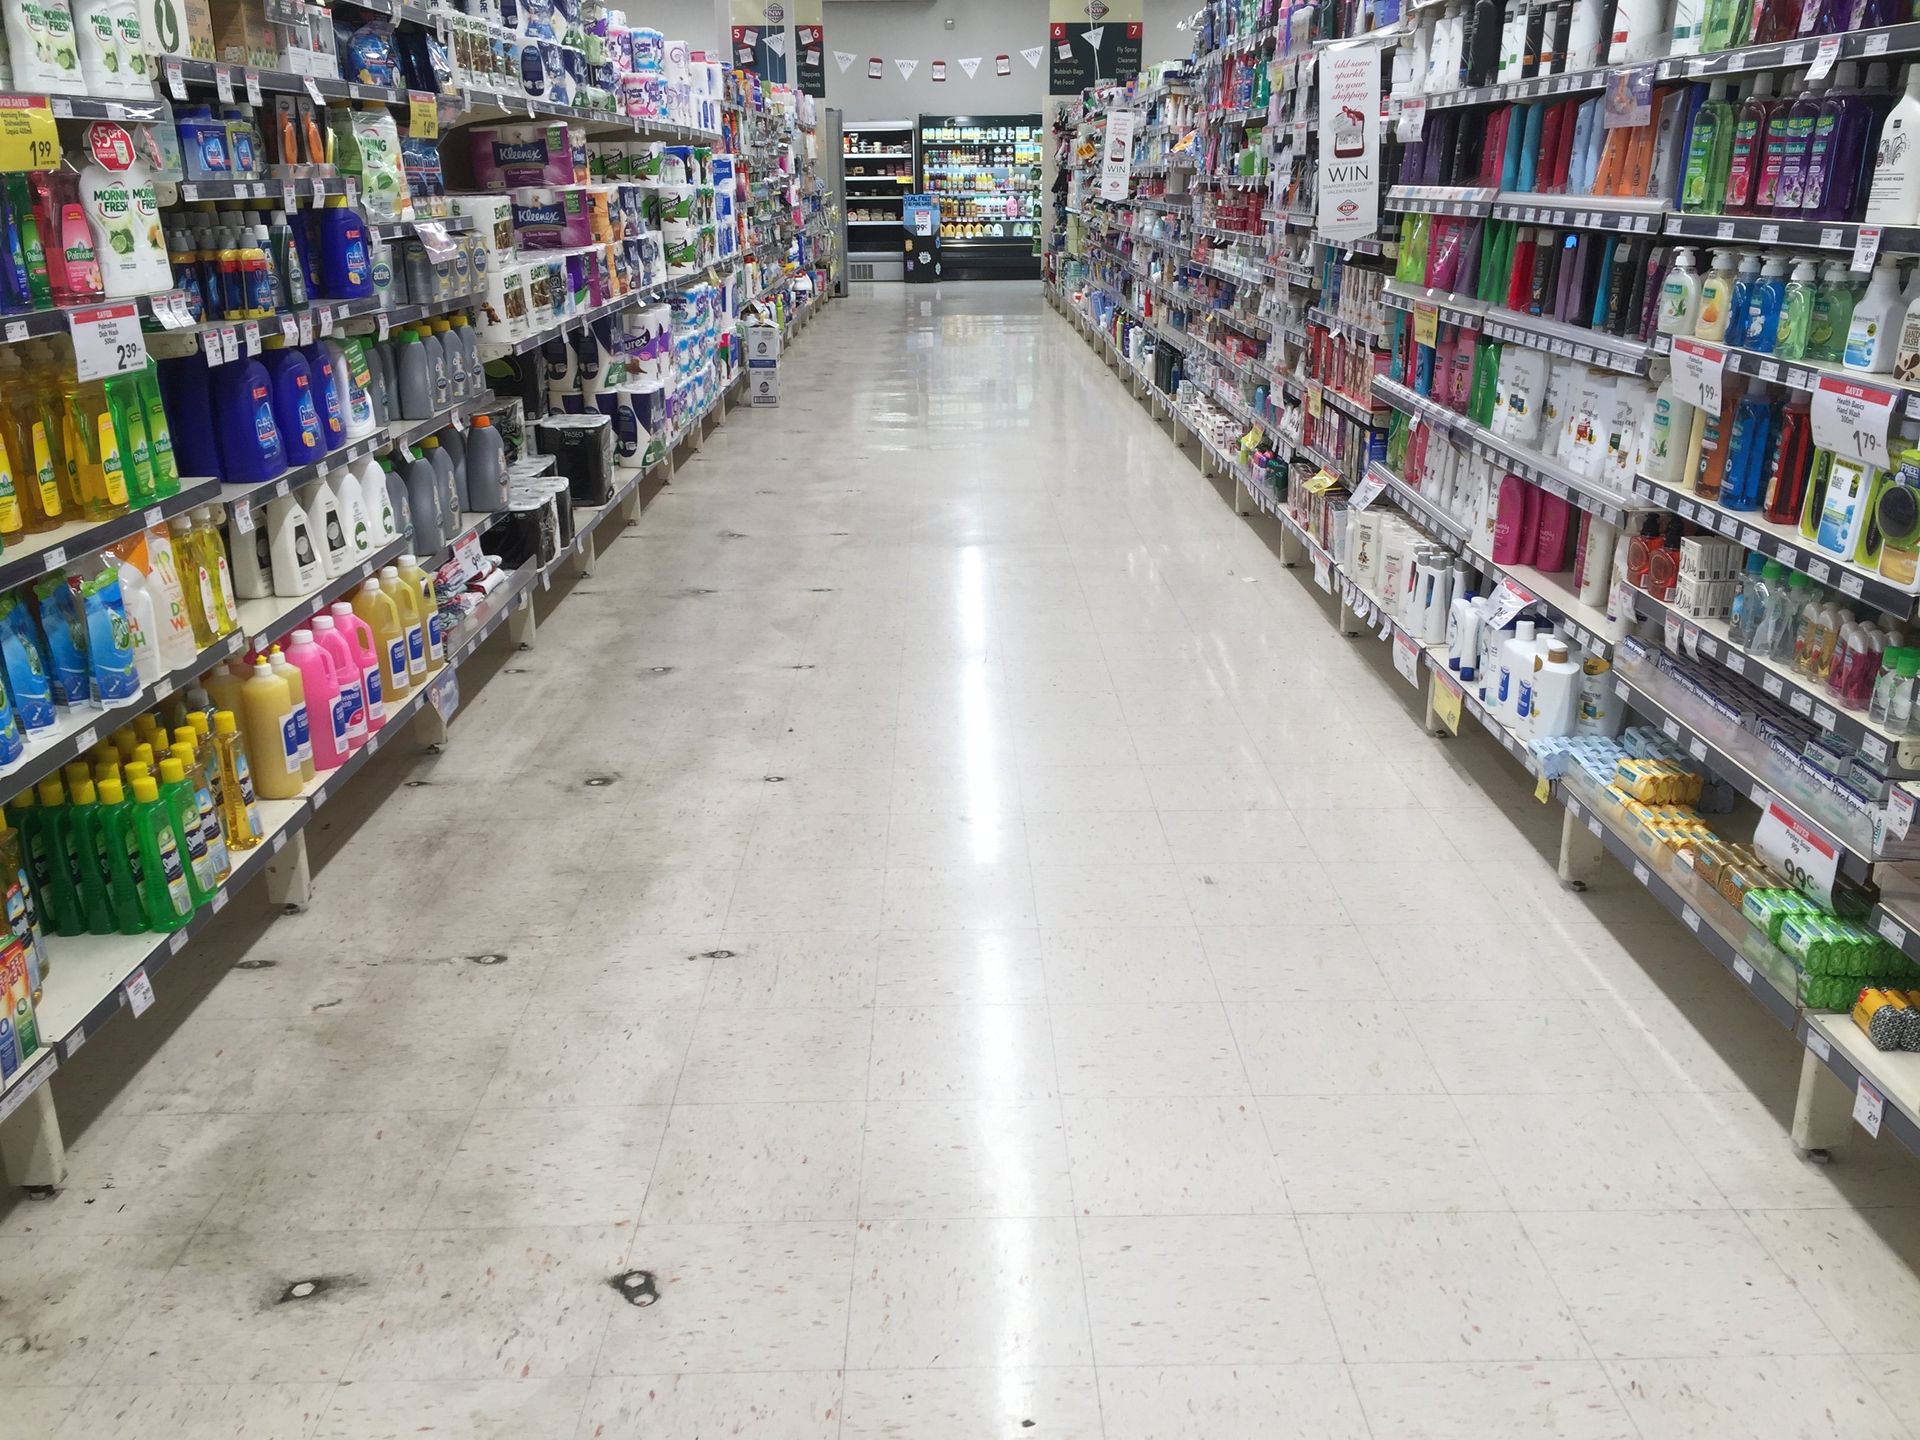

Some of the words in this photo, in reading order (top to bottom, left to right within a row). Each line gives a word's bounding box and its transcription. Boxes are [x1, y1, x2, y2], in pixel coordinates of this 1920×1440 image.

[733, 29, 740, 38] 5
[812, 29, 819, 38] 6
[1054, 26, 1061, 36] 6
[1131, 26, 1138, 35] 7
[1025, 50, 1041, 59] WIN
[898, 61, 914, 70] WIN
[1331, 91, 1369, 102] shopping
[108, 129, 122, 140] OFF
[499, 147, 543, 161] Kleenex
[1107, 165, 1126, 173] WIN
[1328, 165, 1369, 183] WIN
[518, 210, 560, 224] Kleenex
[1844, 385, 1864, 398] SAVER
[1836, 398, 1851, 406] Health
[1851, 401, 1865, 411] Basics
[1836, 407, 1849, 415] Hand
[1849, 410, 1861, 418] Wash
